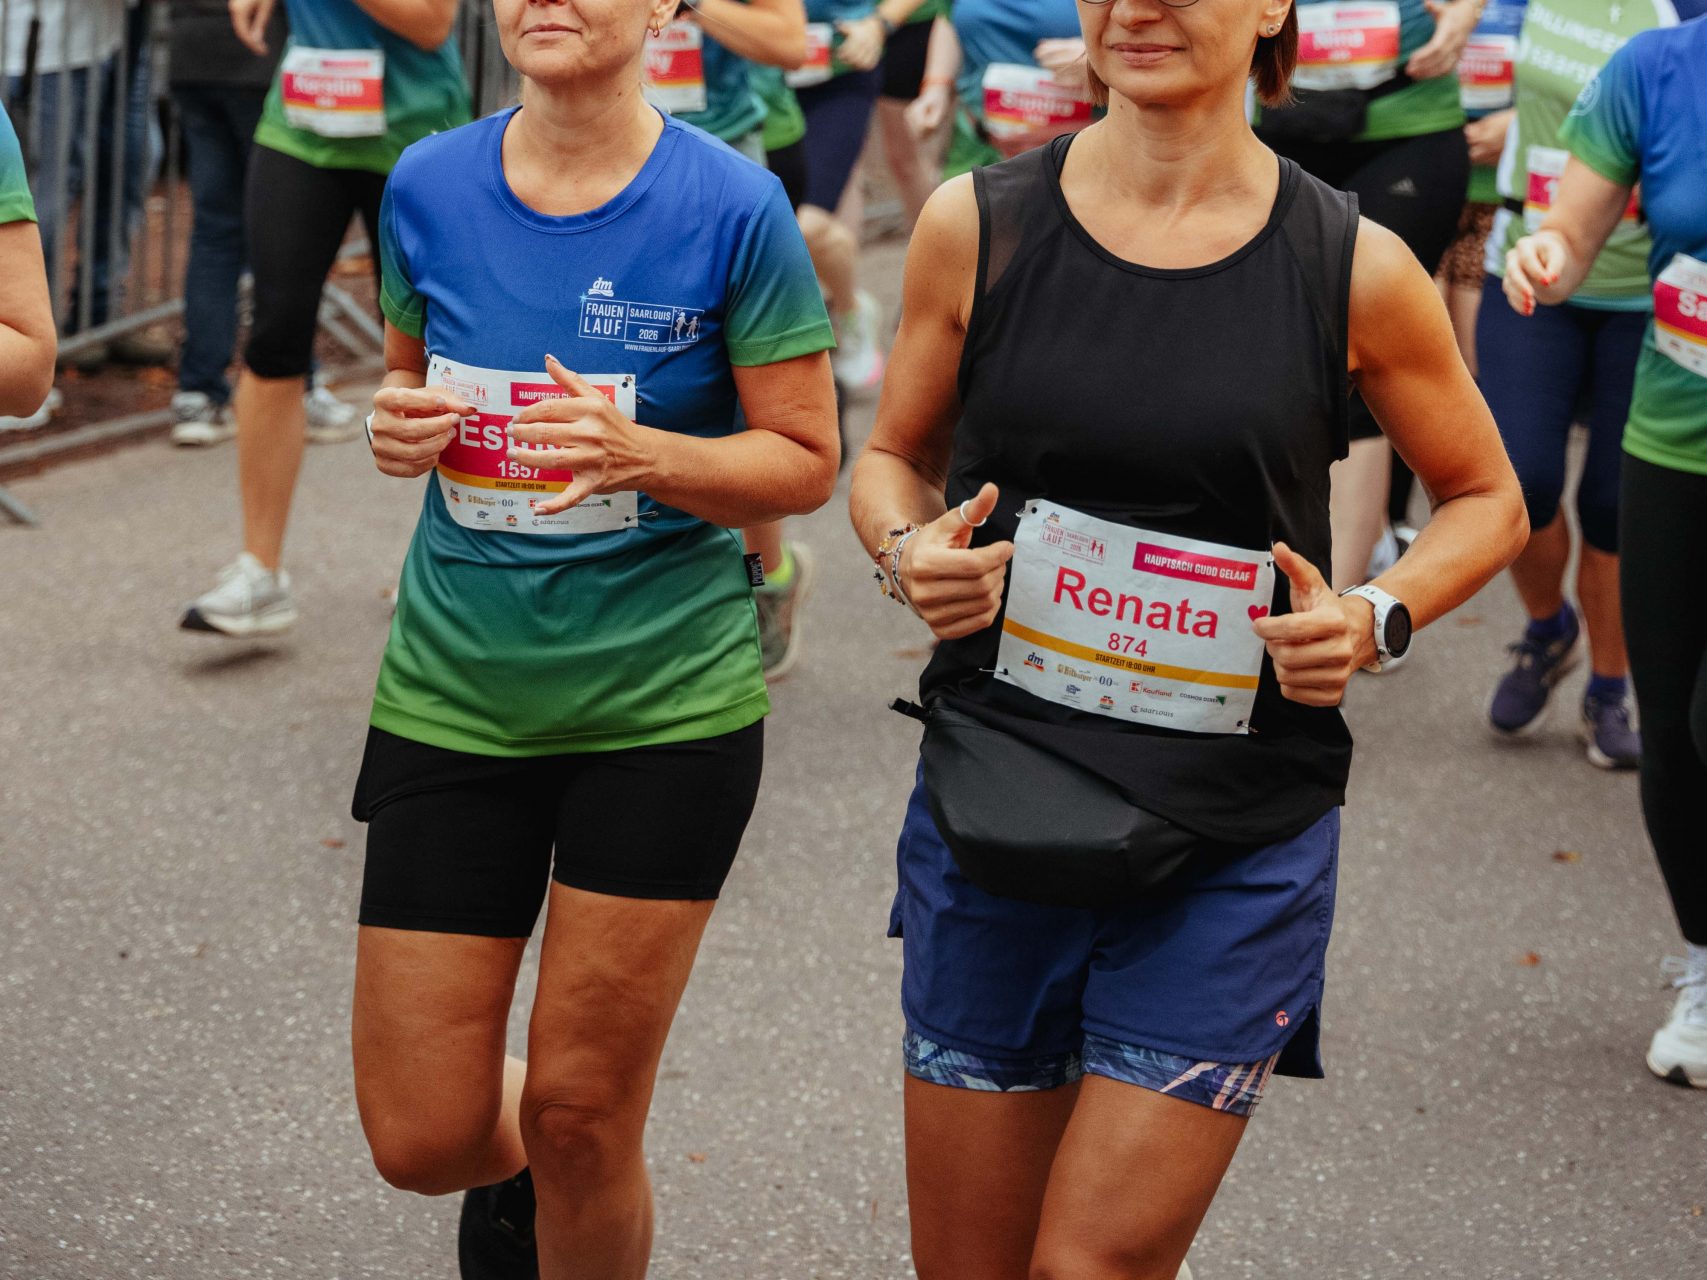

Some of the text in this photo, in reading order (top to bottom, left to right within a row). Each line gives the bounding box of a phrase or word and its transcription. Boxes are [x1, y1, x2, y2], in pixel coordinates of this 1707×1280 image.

[592, 277, 613, 290] dm
[585, 302, 625, 318] FRAUEN
[629, 308, 672, 321] SAARLOUIS
[583, 317, 623, 336] LAUF
[638, 329, 659, 341] 2026
[1042, 531, 1063, 545] LAUF
[1144, 553, 1251, 582] HAUPTSACH GUDD GELAAF
[1052, 566, 1219, 639] Renata
[1107, 632, 1148, 658] 874
[1027, 652, 1044, 666] dm
[1095, 653, 1126, 667] STARTZEIT
[1142, 687, 1173, 698] Kaufland
